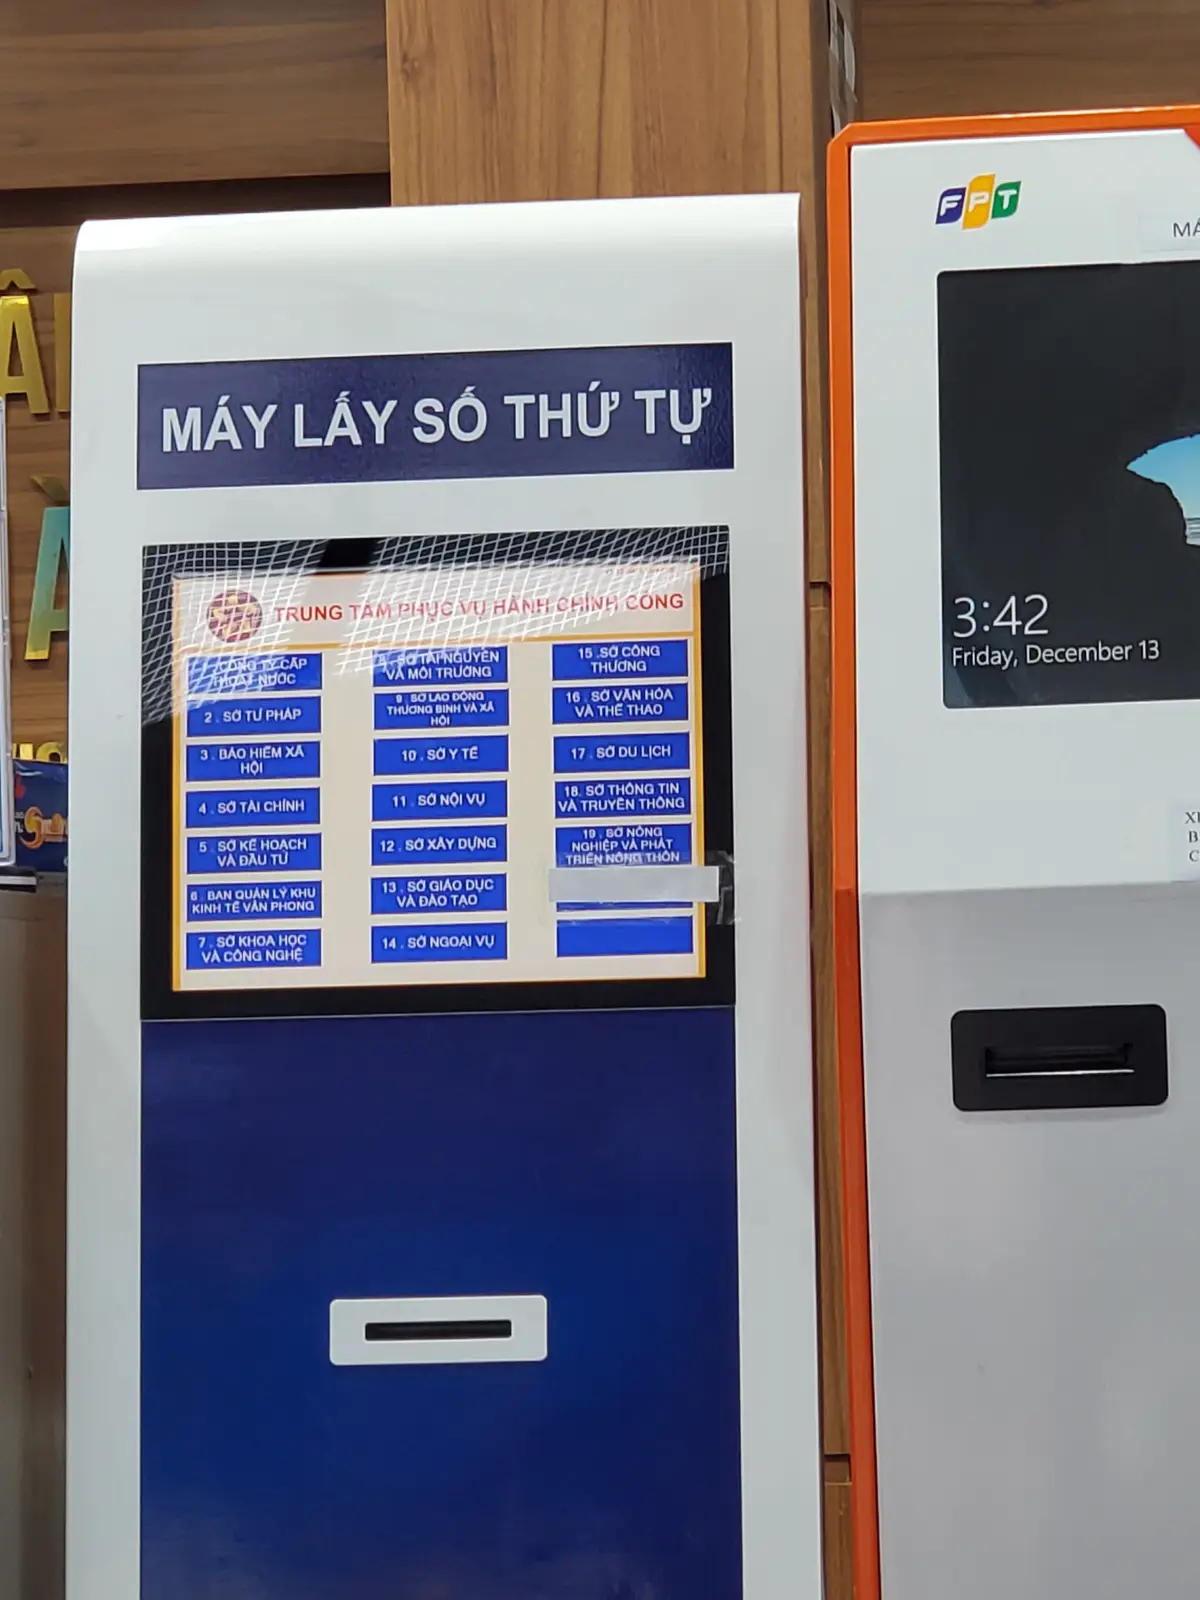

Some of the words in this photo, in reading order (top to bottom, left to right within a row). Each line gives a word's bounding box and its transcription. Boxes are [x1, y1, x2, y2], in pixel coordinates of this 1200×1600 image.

[938, 186, 1019, 220] FPT
[162, 395, 278, 452] MÁY
[294, 391, 398, 448] LẤY
[412, 386, 487, 443] SỐ
[503, 380, 620, 439] THỨ
[634, 388, 712, 445] TỰ
[274, 605, 343, 622] TRUNG
[626, 590, 684, 610] CÔNG
[953, 594, 1049, 637] 3:42
[579, 648, 592, 659] 15
[622, 644, 660, 657] CÔNG
[952, 645, 1018, 670] Friday,
[1026, 640, 1133, 664] December
[1139, 640, 1160, 659] 13
[281, 657, 307, 670] CẤP
[591, 660, 647, 673] THƯƠNG
[386, 667, 404, 680] VÀ
[408, 666, 432, 679] MÔI
[436, 665, 492, 678] TRƯỜNG
[429, 693, 449, 702] LAO
[566, 691, 580, 703] 16
[591, 689, 610, 702] SỞ
[223, 709, 241, 722] SỞ
[245, 708, 262, 722] TƯ
[266, 707, 301, 721] PHÁP
[435, 704, 461, 714] BINH
[463, 702, 477, 712] VÀ
[575, 704, 594, 718] VÀ
[627, 704, 663, 716] THAO
[402, 750, 417, 761] 10
[427, 747, 446, 760] SỞ
[449, 749, 458, 760] Y
[461, 746, 478, 760] TẾ
[571, 748, 585, 760] 17
[596, 746, 615, 758] SỞ
[619, 746, 637, 758] DU
[641, 745, 671, 759] LỊCH
[241, 761, 263, 776] HỘI
[586, 784, 604, 796] SỞ
[608, 782, 654, 796] THÔNG
[658, 783, 679, 794] TIN
[217, 800, 236, 813] SỞ
[240, 799, 260, 813] TÀI
[264, 798, 305, 812] CHÍNH
[392, 796, 406, 808] 11
[418, 793, 436, 806] SỞ
[440, 792, 463, 808] NỘI
[466, 793, 485, 807] VỤ
[558, 799, 577, 812] VÀ
[639, 797, 685, 809] THÔNG
[627, 826, 663, 838] NÔNG
[218, 839, 236, 852] SỞ
[240, 838, 257, 851] KẾ
[261, 838, 307, 852] HOẠCH
[380, 840, 394, 852] 12
[405, 838, 424, 851] SỞ
[427, 836, 455, 850] XÂY
[458, 836, 496, 852] DỰNG
[572, 839, 618, 852] NGHIỆP
[621, 838, 638, 850] VÀ
[641, 837, 673, 849] PHÁT
[217, 854, 236, 867] VÀ
[240, 853, 267, 866] ĐẦU
[646, 850, 680, 862] THÔN
[383, 882, 396, 893] 13
[407, 879, 426, 892] SỞ
[429, 878, 462, 891] GIÁO
[466, 879, 494, 892] DỤC
[207, 890, 232, 901] BAN
[235, 887, 270, 900] QUẢN
[273, 886, 287, 899] LÝ
[290, 888, 316, 899] KHU
[397, 894, 416, 908] VÀ
[419, 893, 447, 907] ĐÀO
[451, 895, 478, 908] TẠO
[192, 903, 221, 914] KINH
[225, 901, 240, 913] TẾ
[271, 901, 314, 912] PHONG
[217, 935, 235, 948] SỞ
[239, 935, 275, 947] KHOA
[279, 934, 307, 948] HỌC
[383, 938, 396, 949] 14
[407, 936, 426, 948] SỞ
[430, 936, 472, 950] NGOẠI
[475, 935, 494, 948] VỤ
[201, 949, 221, 963] VÀ
[224, 949, 262, 962] CÔNG
[266, 948, 303, 963] NGHỆ
